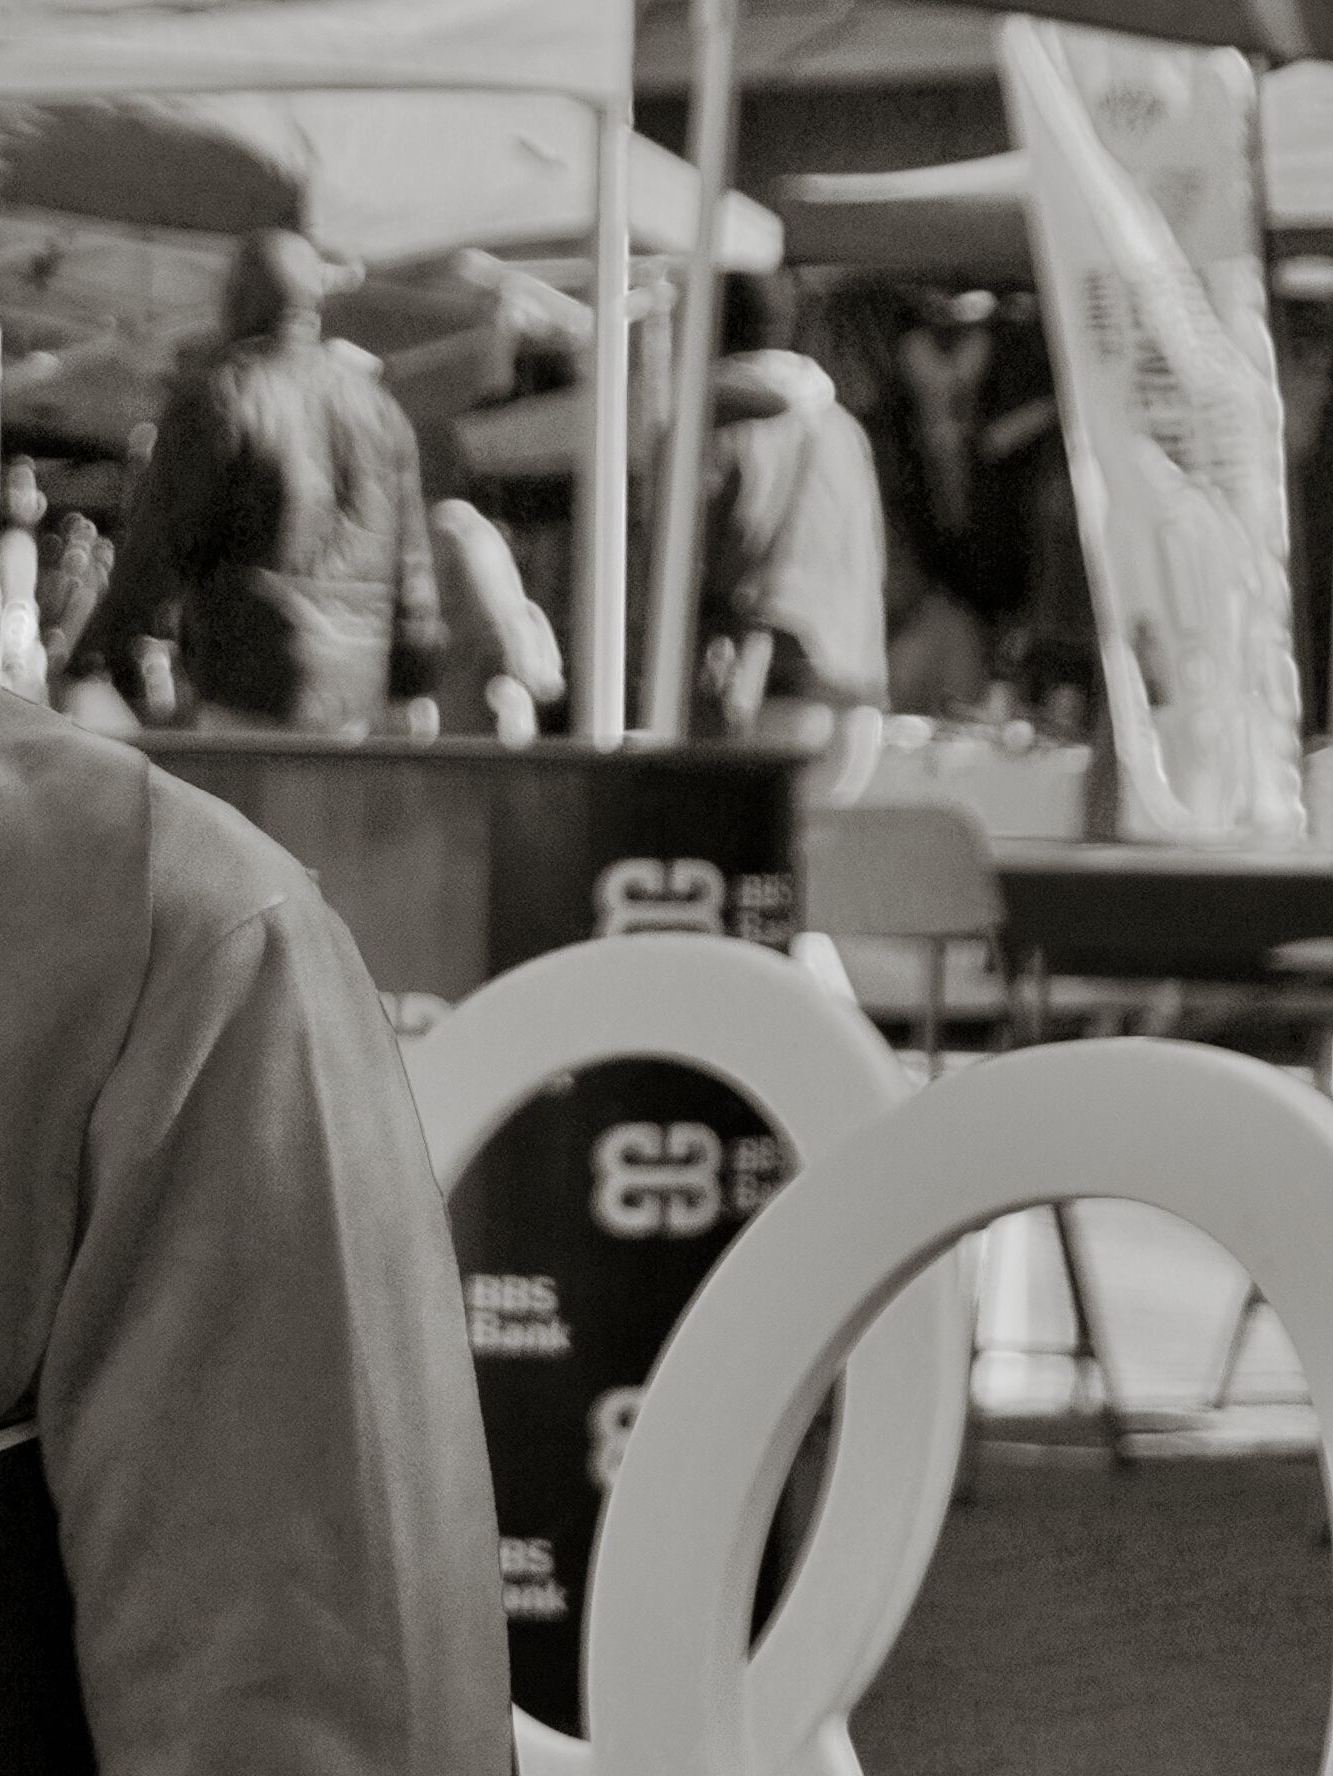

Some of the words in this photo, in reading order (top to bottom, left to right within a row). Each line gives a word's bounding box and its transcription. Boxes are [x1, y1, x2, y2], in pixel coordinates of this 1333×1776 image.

[472, 1274, 558, 1309] BBS
[472, 1311, 572, 1352] Bank
[499, 1538, 554, 1573] BS
[502, 1579, 567, 1615] ank
